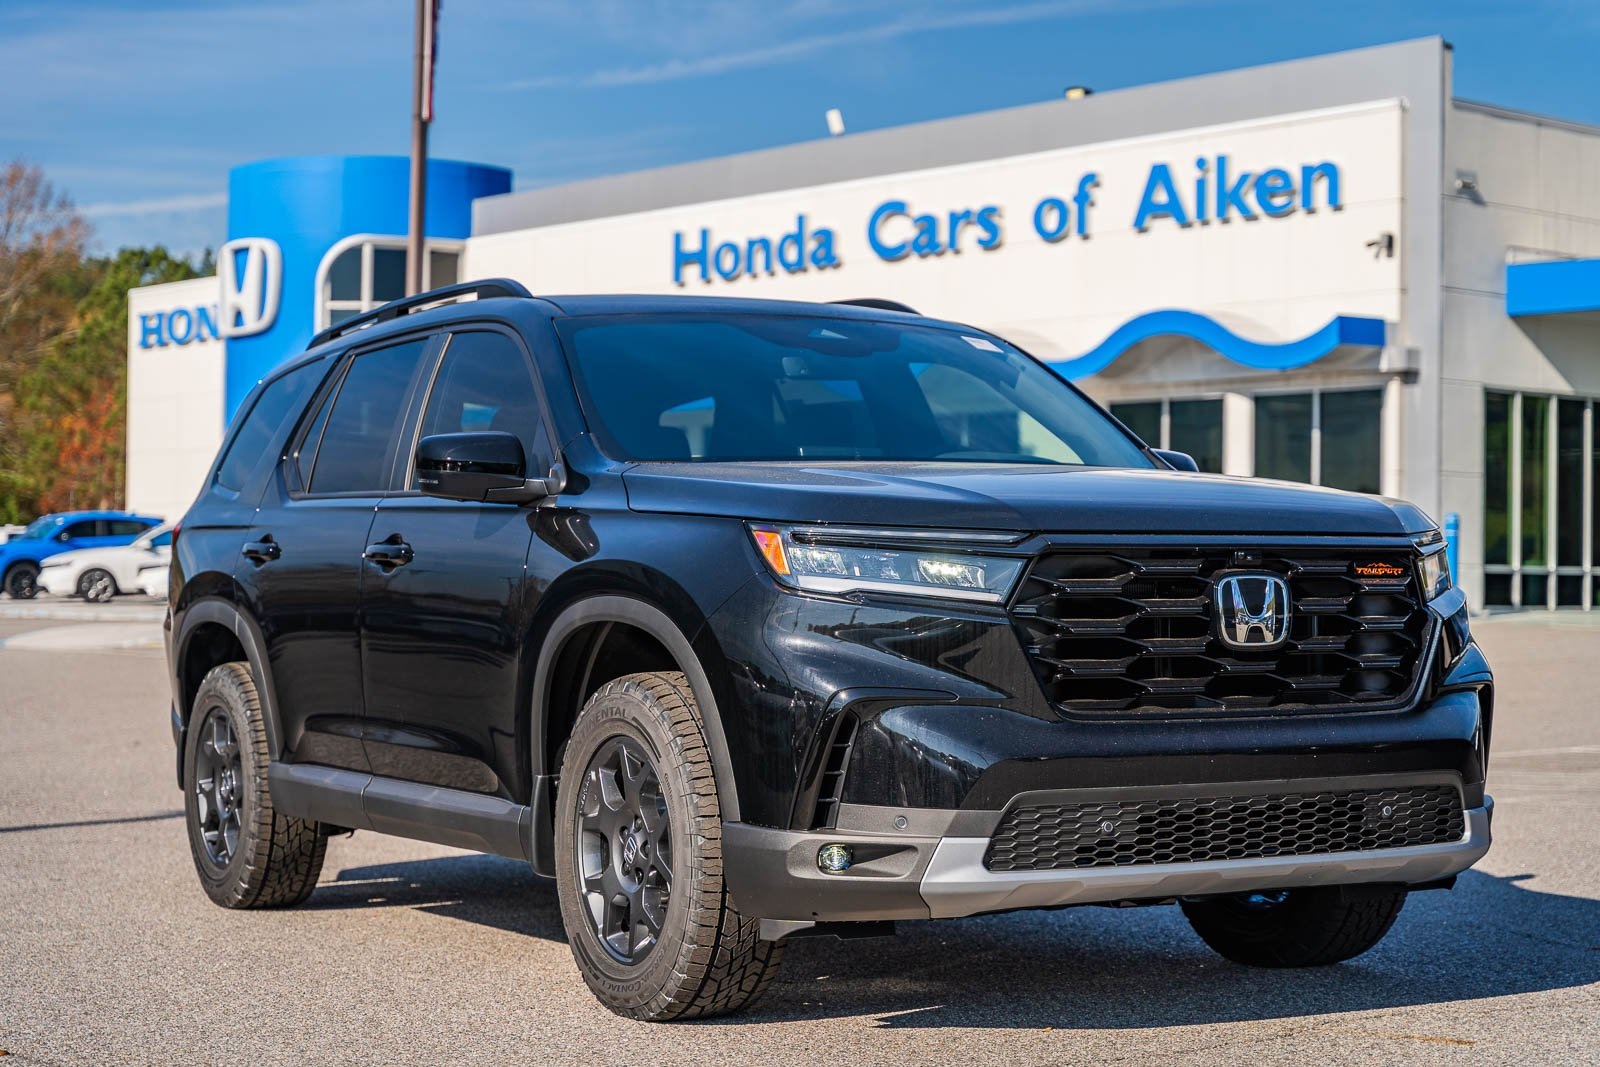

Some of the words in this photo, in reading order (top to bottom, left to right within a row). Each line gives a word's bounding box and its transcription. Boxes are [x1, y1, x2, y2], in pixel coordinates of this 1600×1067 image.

[672, 213, 839, 285] Honda
[867, 200, 1002, 262] Cars
[1033, 172, 1099, 242] of
[1133, 155, 1341, 232] Aiken
